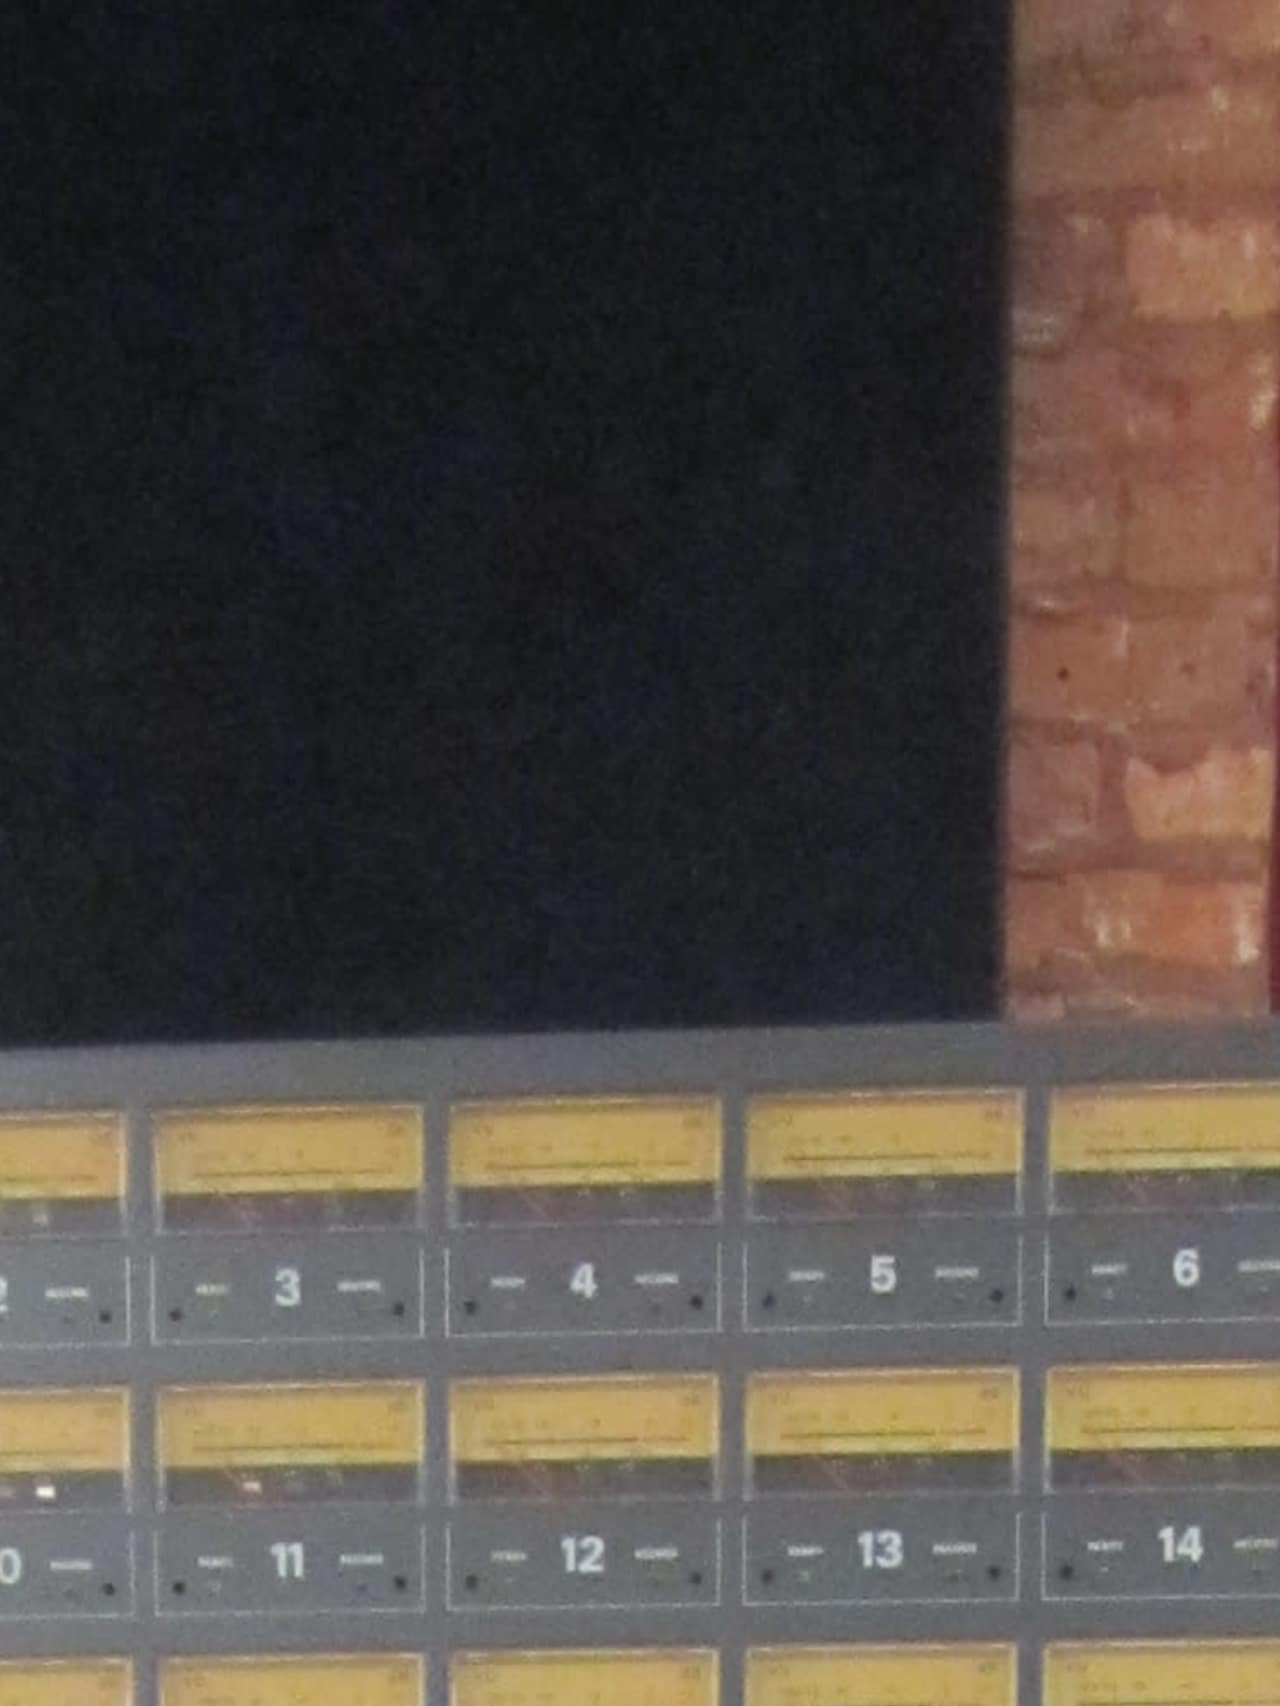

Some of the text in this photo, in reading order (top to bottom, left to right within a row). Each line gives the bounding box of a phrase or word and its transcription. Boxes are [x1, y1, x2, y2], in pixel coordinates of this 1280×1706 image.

[274, 1267, 302, 1308] 3
[569, 1262, 599, 1299] 4
[869, 1254, 898, 1294] 5
[1172, 1247, 1201, 1288] 6
[270, 1541, 305, 1579] 11
[560, 1534, 606, 1574] 12
[857, 1529, 904, 1569] 13
[1157, 1525, 1205, 1564] 14
